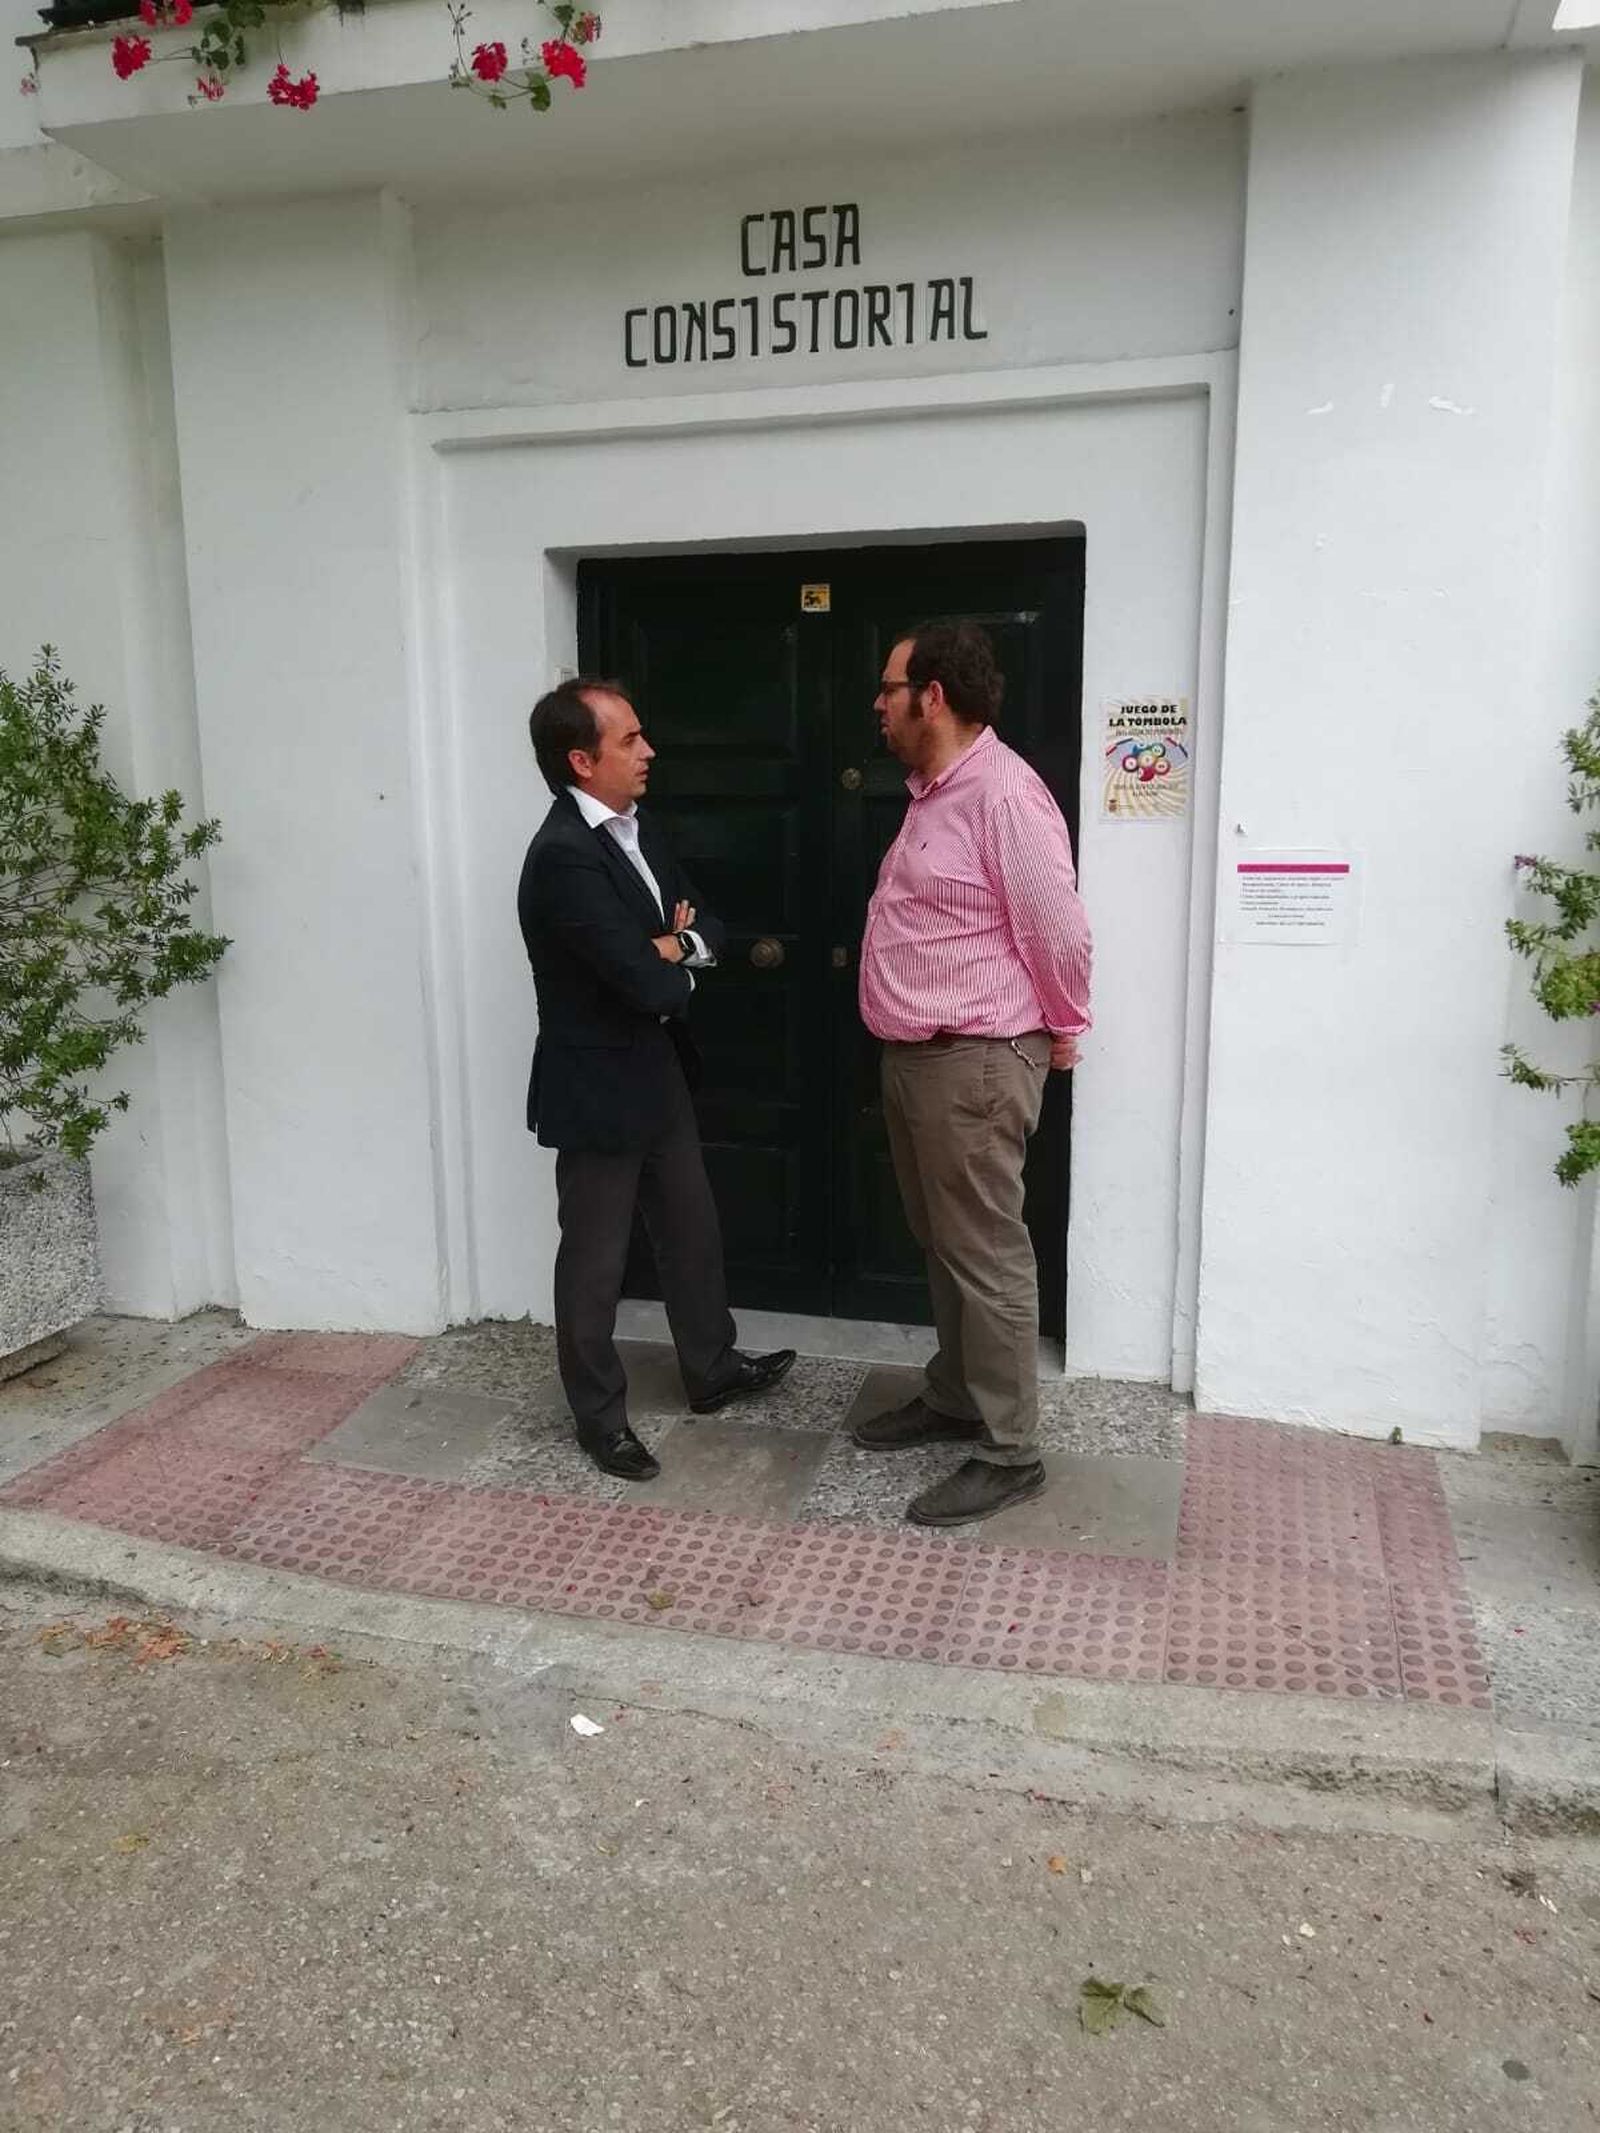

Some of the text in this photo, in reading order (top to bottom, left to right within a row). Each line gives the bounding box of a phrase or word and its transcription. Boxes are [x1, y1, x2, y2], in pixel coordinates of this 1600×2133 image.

[741, 203, 861, 276] CASA
[625, 277, 988, 367] CONSISTORIAL
[1109, 718, 1125, 727] LA
[1121, 705, 1178, 714] JUEGO DE
